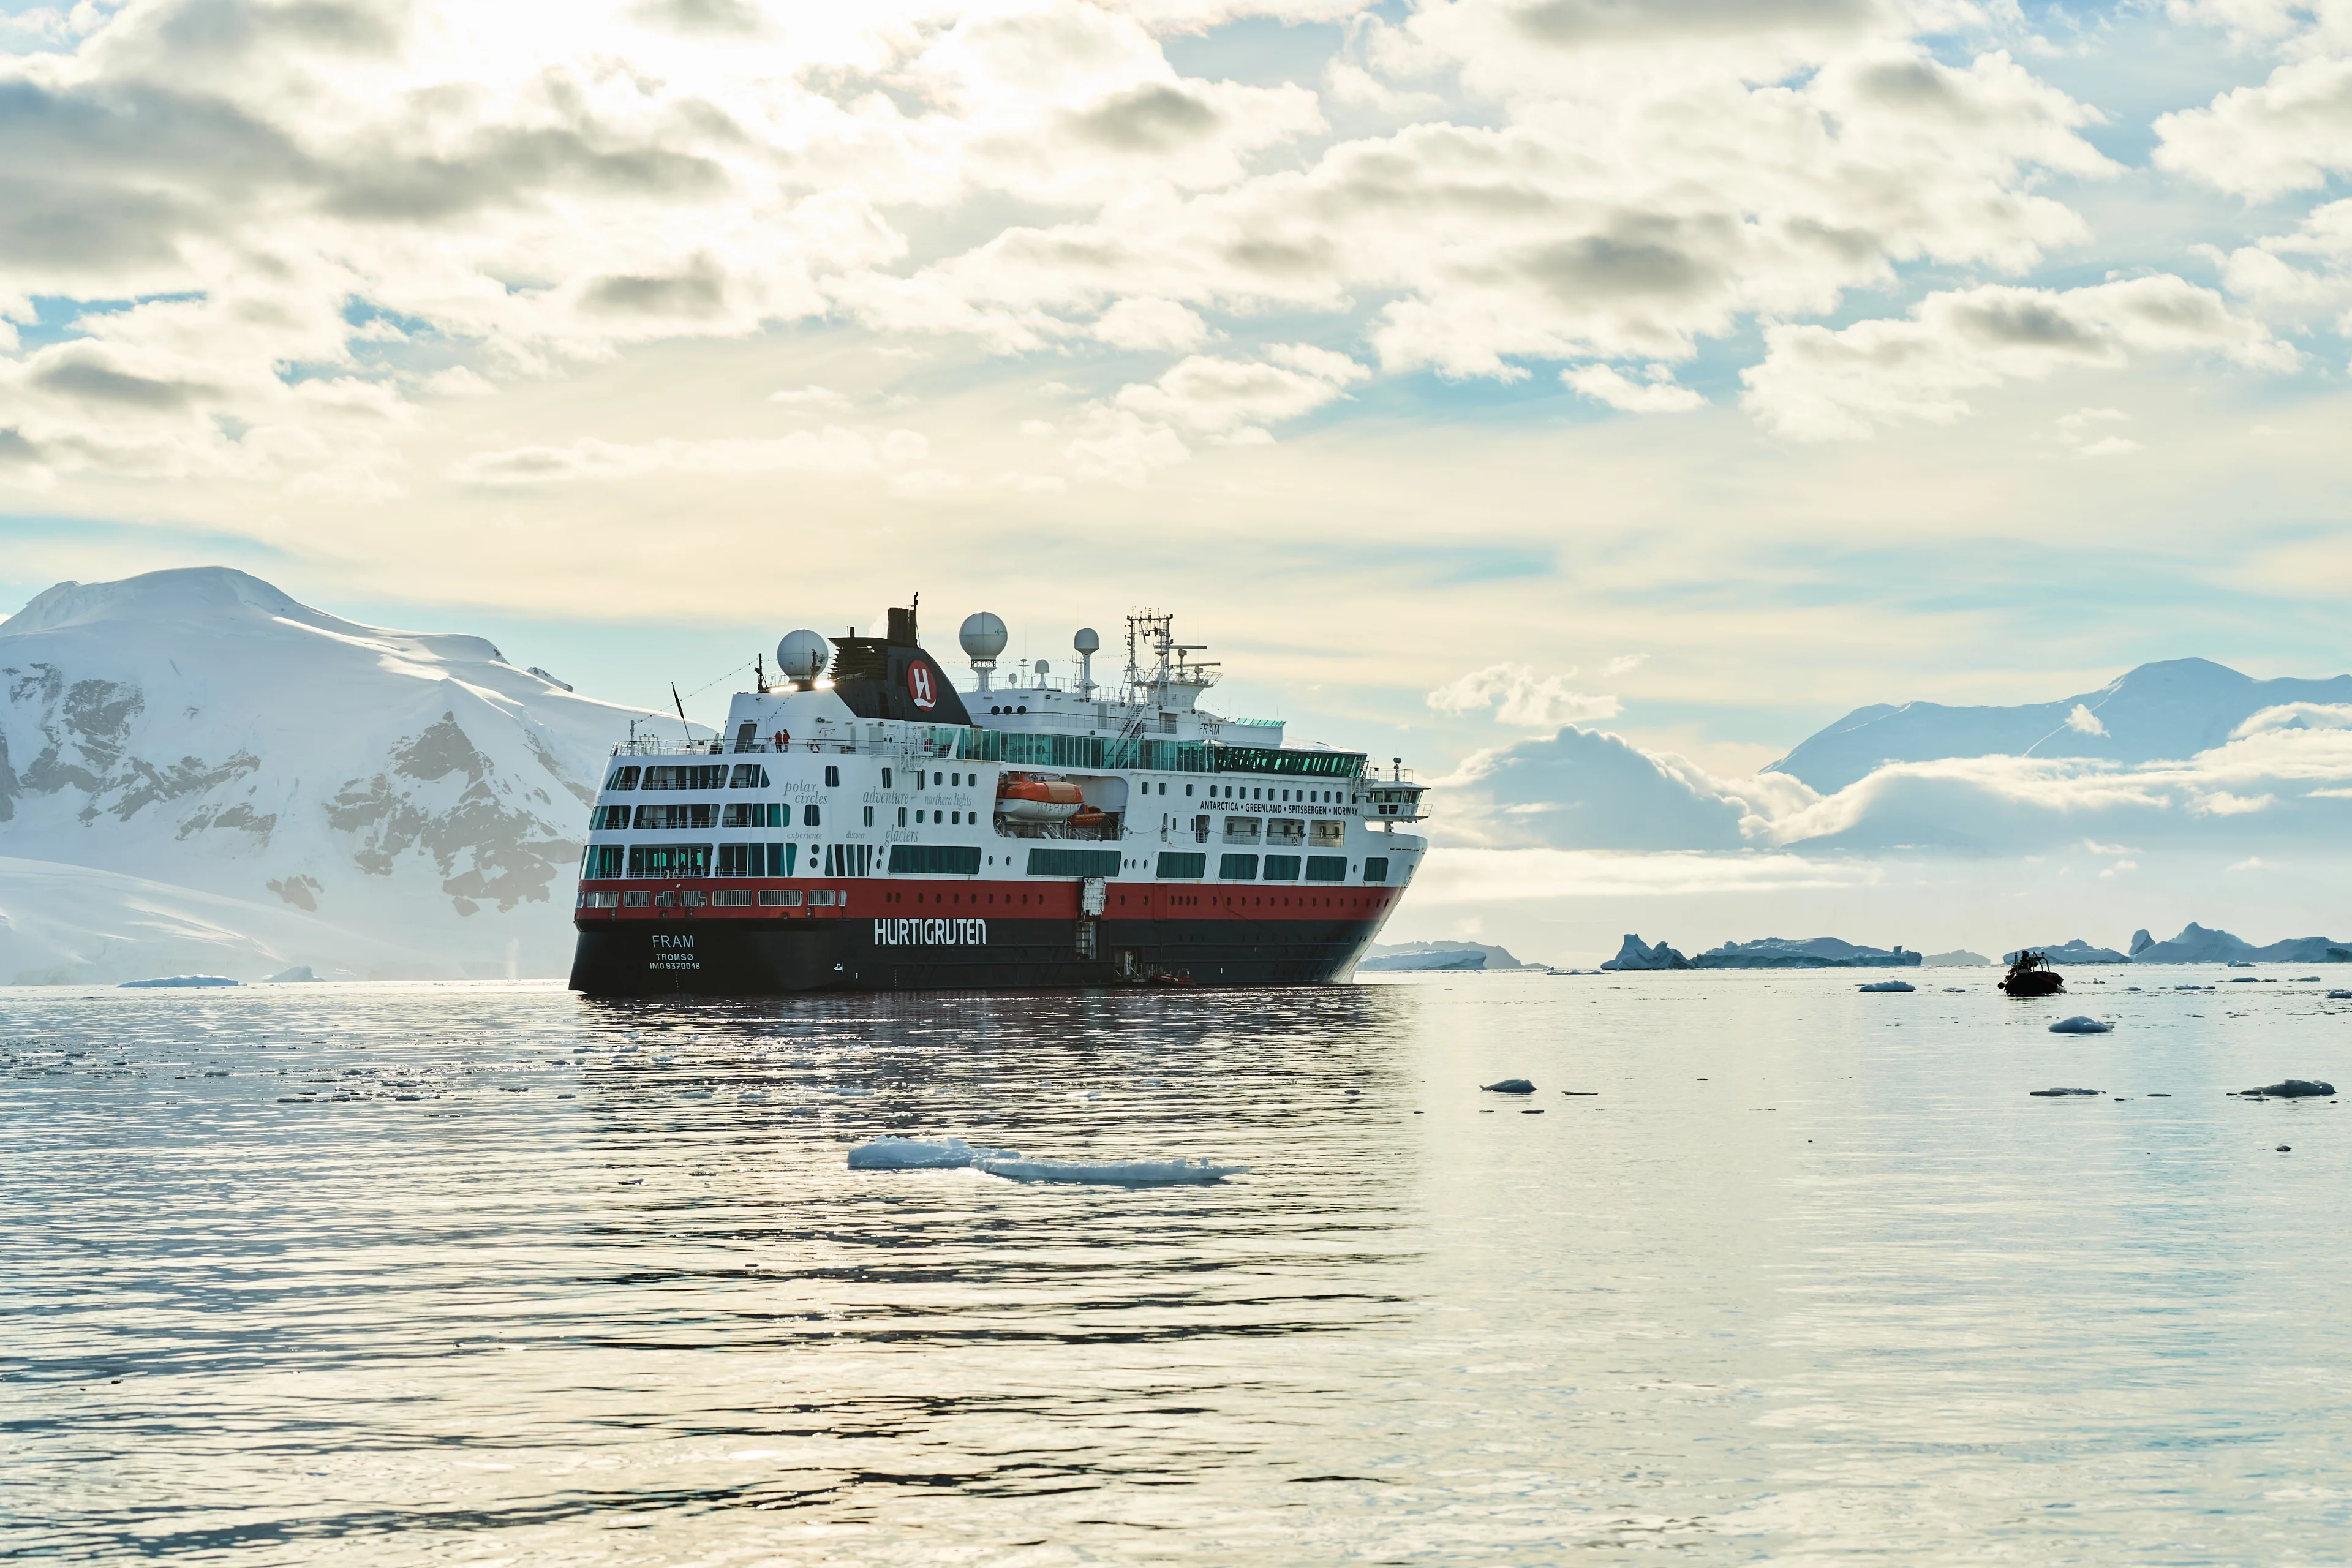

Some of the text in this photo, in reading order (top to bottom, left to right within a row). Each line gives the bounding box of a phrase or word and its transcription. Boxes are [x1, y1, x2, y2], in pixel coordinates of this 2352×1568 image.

[783, 779, 816, 796] polar
[863, 786, 909, 804] adventure
[794, 791, 827, 804] circles
[924, 793, 973, 810] northern lights
[1200, 801, 1359, 816] ANTARCTICA GREENLAND SPITSBERGEN NORWAY
[786, 832, 823, 841] experience
[846, 830, 865, 839] discover
[884, 824, 919, 847] glaciers
[875, 919, 986, 945] HURTIGRUTEN
[652, 935, 694, 948] FRAM
